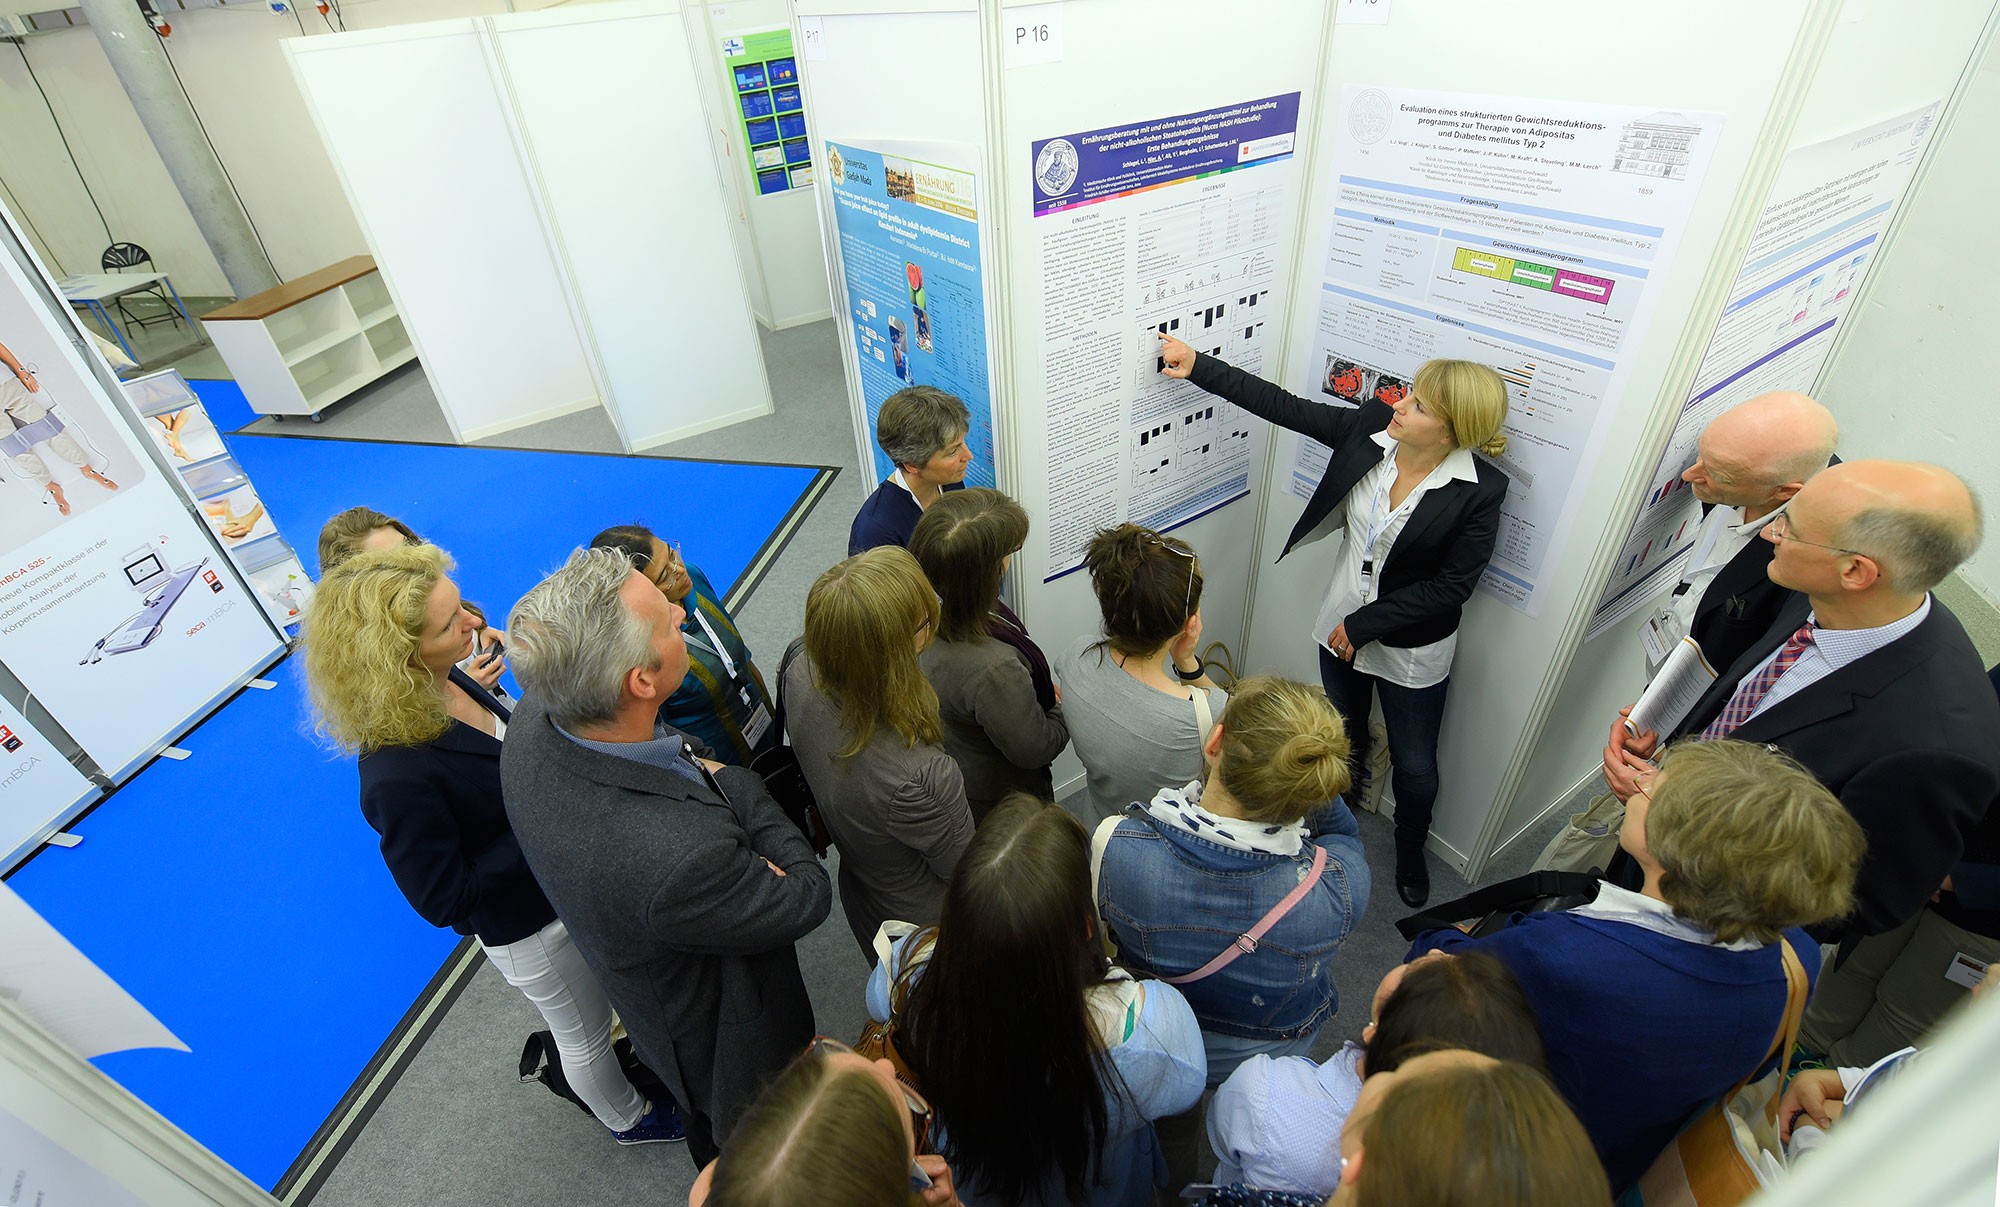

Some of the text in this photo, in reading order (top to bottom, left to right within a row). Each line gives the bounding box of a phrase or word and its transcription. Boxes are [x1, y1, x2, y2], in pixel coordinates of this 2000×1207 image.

[806, 30, 810, 42] P
[812, 30, 818, 42] 17
[1016, 24, 1048, 44] P 16
[1082, 128, 1140, 145] Ernährungsberatung
[1140, 126, 1150, 134] mit
[1150, 123, 1162, 132] und
[1162, 120, 1176, 130] ohne
[1250, 102, 1278, 113] Behandlung
[1400, 104, 1606, 130] Evaluation eines strukturierten Gewichtsreduktions-
[1098, 144, 1110, 152] der
[1110, 134, 1162, 150] nicht-alkoholischen
[1219, 118, 1233, 128] NASH
[1418, 118, 1459, 128] programms
[1476, 122, 1509, 133] Therapie
[1528, 128, 1576, 140] Adipositas
[1454, 130, 1486, 142] Diabetes
[1488, 136, 1520, 146] mellitus
[1523, 138, 1538, 148] Typ
[1540, 140, 1546, 148] 2
[1146, 144, 1160, 153] Erste
[1160, 132, 1220, 150] Behandlungsergebnisse
[844, 158, 868, 170] Universitas
[916, 173, 955, 194] ERNÄHRUNG
[1460, 196, 1498, 208] Fragestellung
[1072, 212, 1100, 224] EINLEITUNG
[1374, 216, 1395, 226] Methodik
[1492, 240, 1584, 264] Gewichtsreduktionsprogramm
[1634, 240, 1645, 249] Typ
[1436, 315, 1464, 327] Ergebnisse
[0, 538, 108, 604] neue Kompaktklasse in der
[28, 558, 46, 571] 525
[28, 582, 64, 603] Analyse
[64, 572, 78, 584] der
[2, 570, 108, 636] Körperzusammensetzung.
[186, 600, 237, 638] seca mBCA
[1, 756, 42, 788] mBCA
